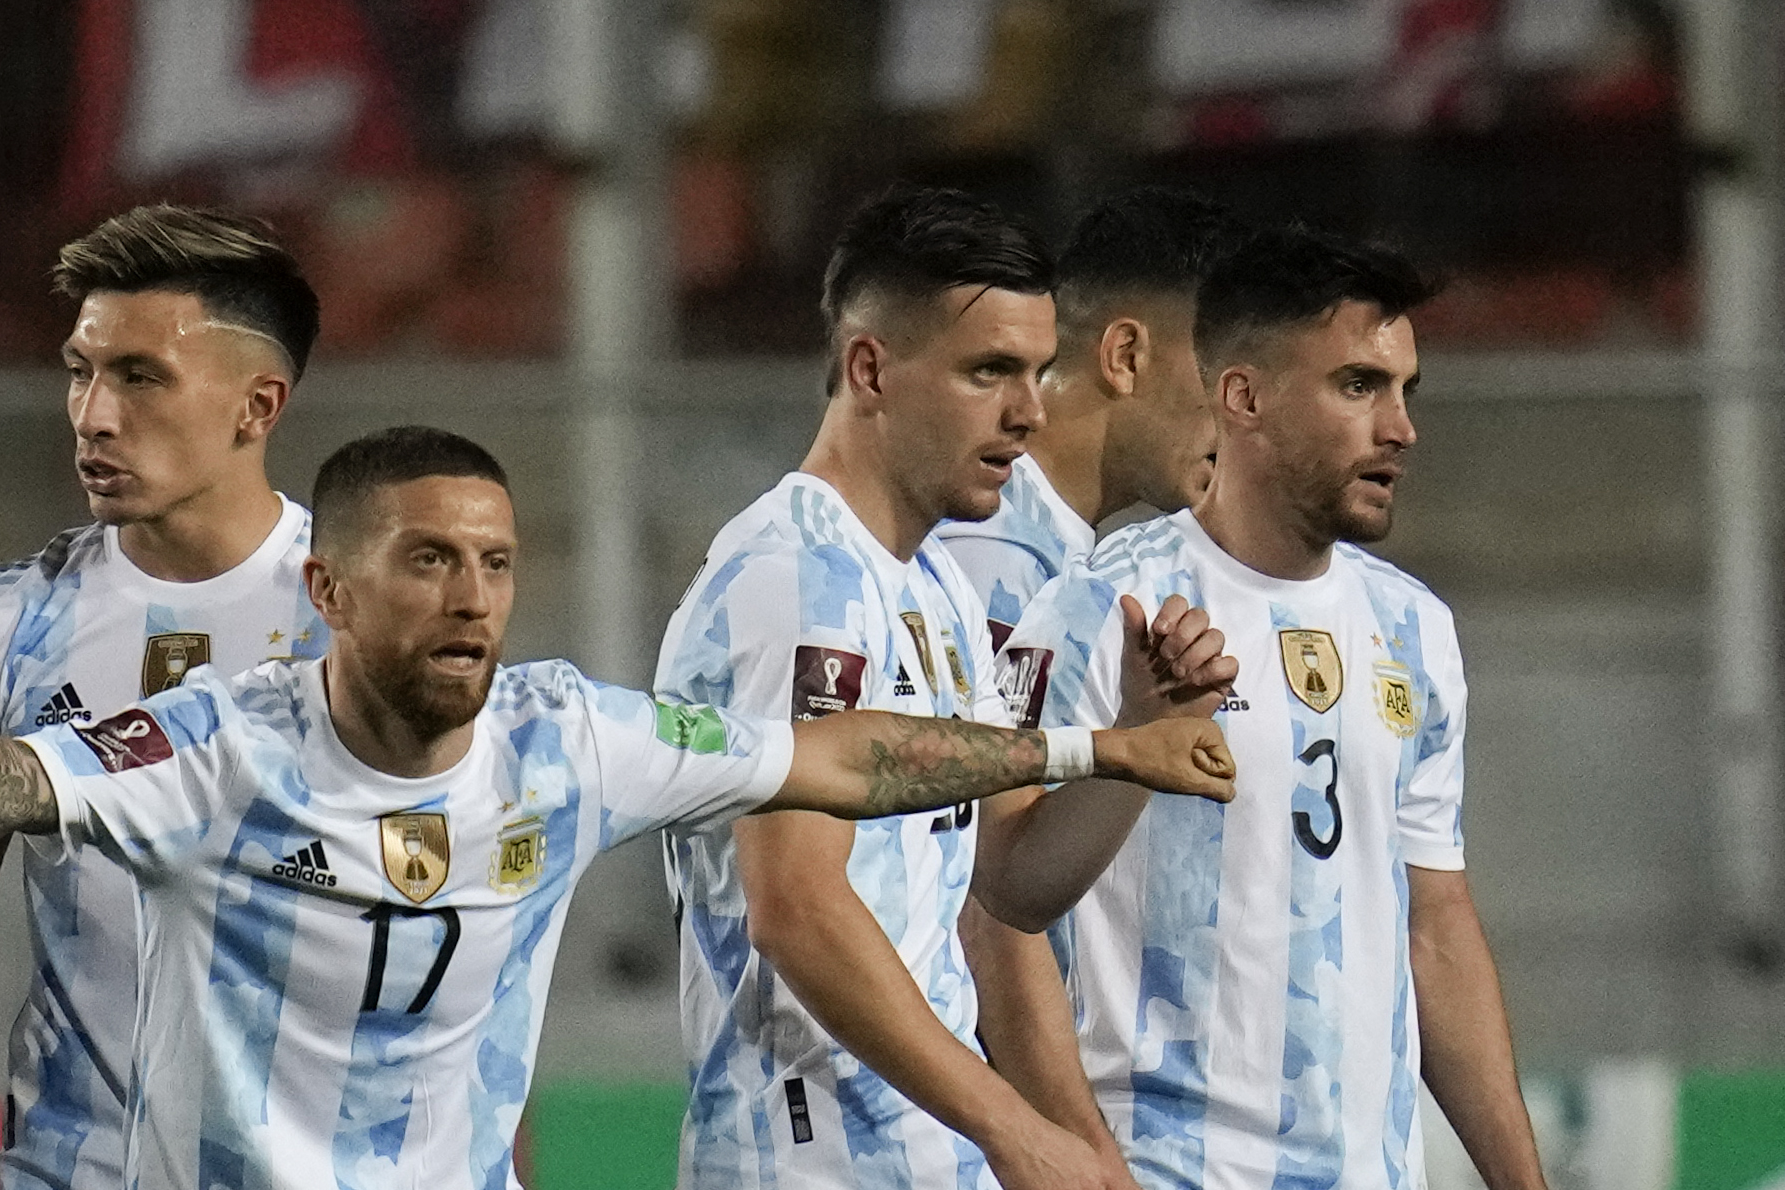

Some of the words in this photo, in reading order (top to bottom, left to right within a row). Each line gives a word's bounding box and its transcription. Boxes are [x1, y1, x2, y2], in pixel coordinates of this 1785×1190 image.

[1218, 695, 1250, 712] das
[35, 708, 92, 727] adidas
[1291, 739, 1343, 860] 3
[272, 862, 337, 888] adidas
[359, 901, 461, 1015] 17
